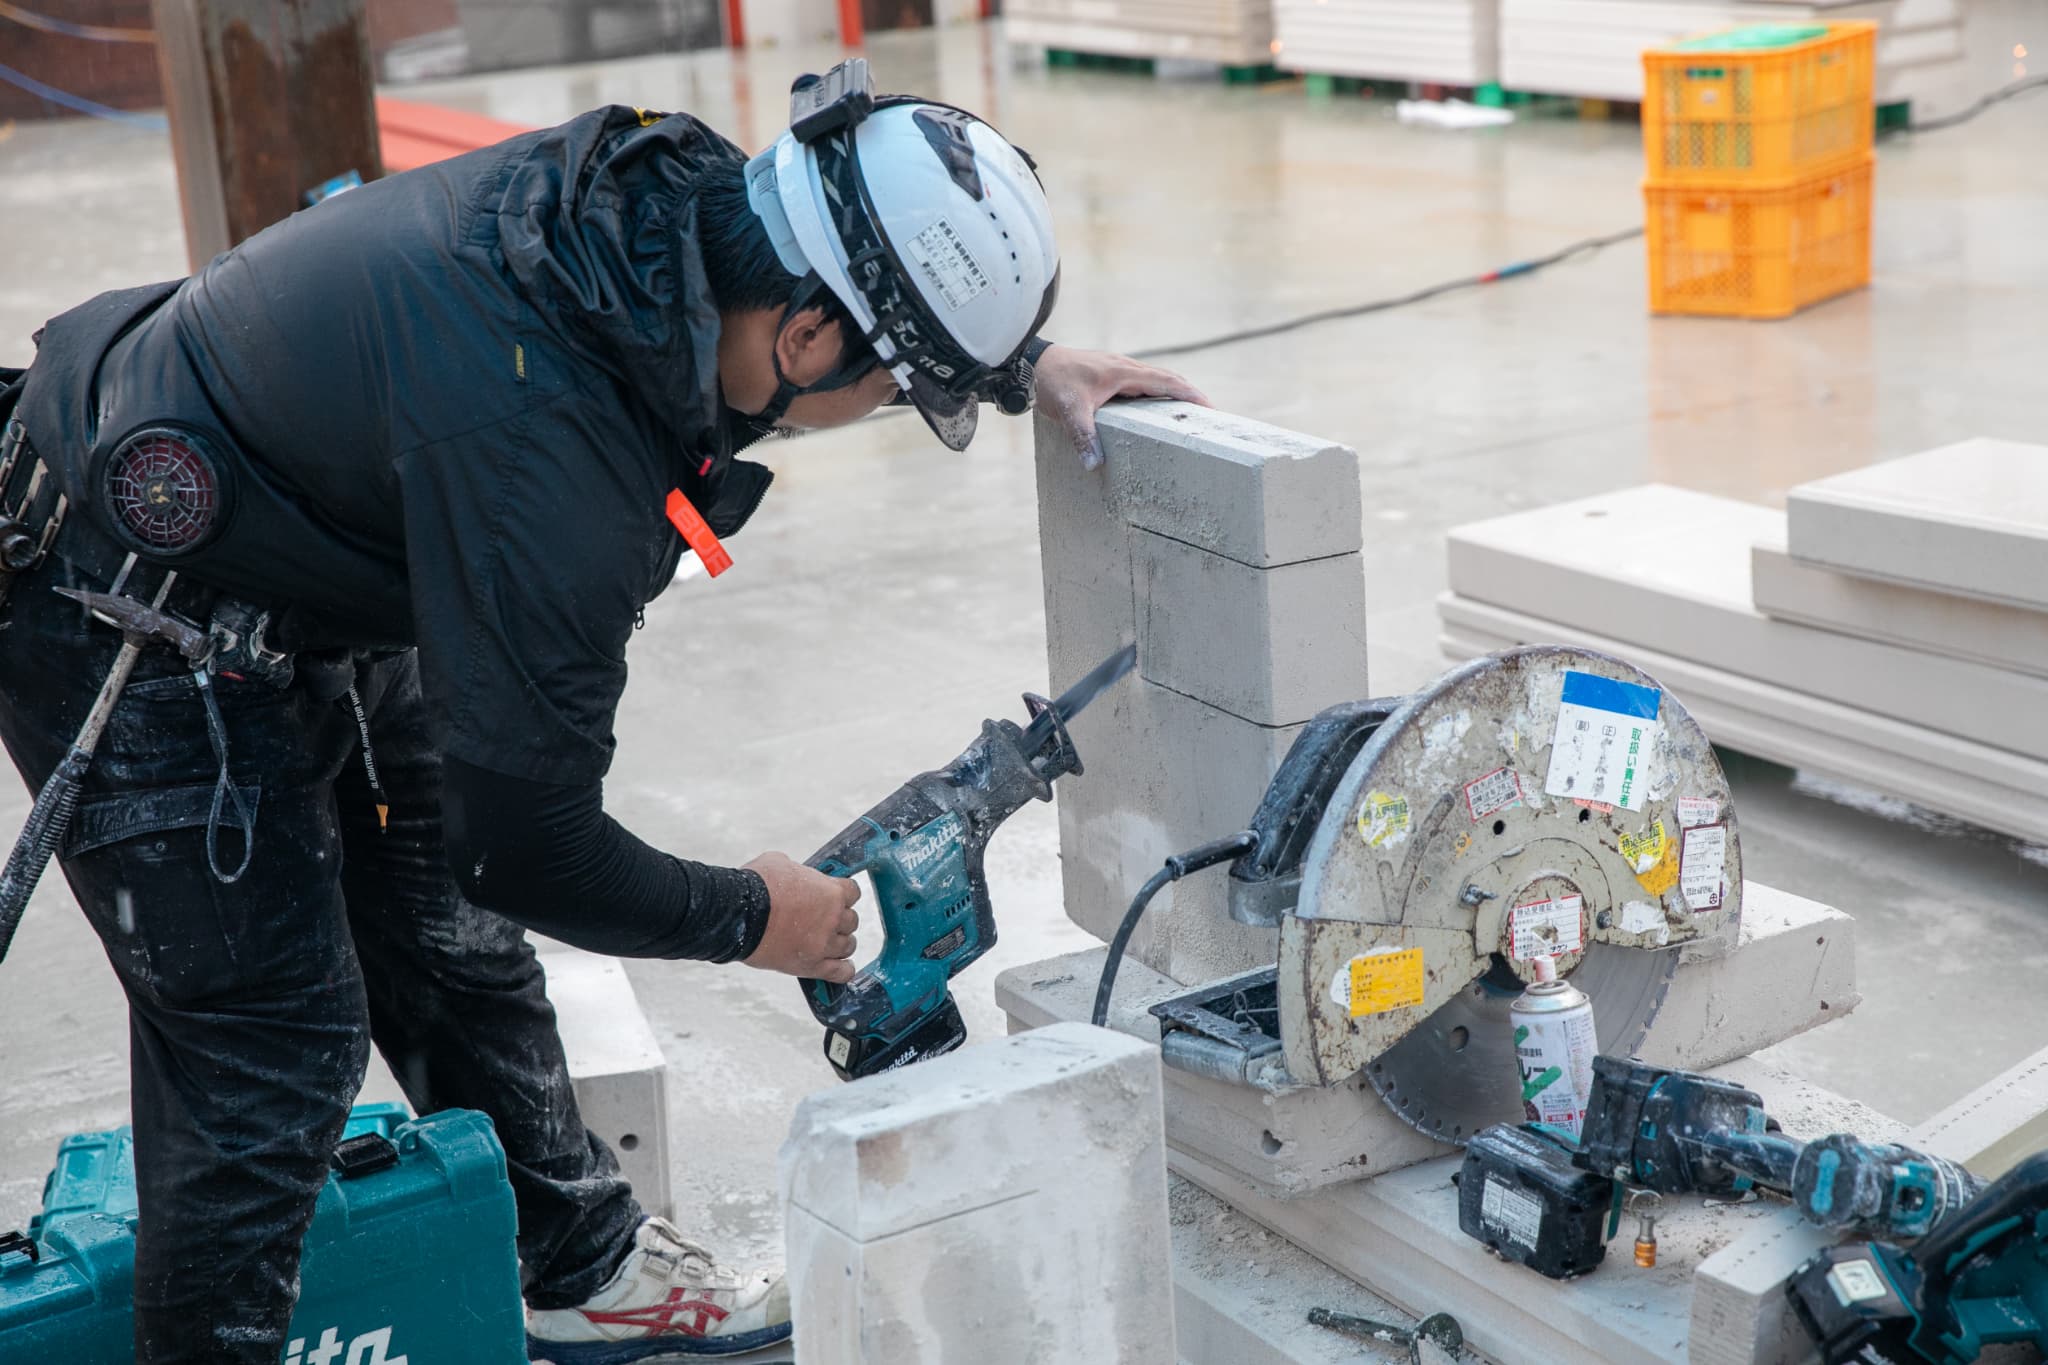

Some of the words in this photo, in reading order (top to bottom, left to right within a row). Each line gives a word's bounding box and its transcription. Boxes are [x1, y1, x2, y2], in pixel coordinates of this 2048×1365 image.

[1618, 726, 1643, 808] 取扱い責任者
